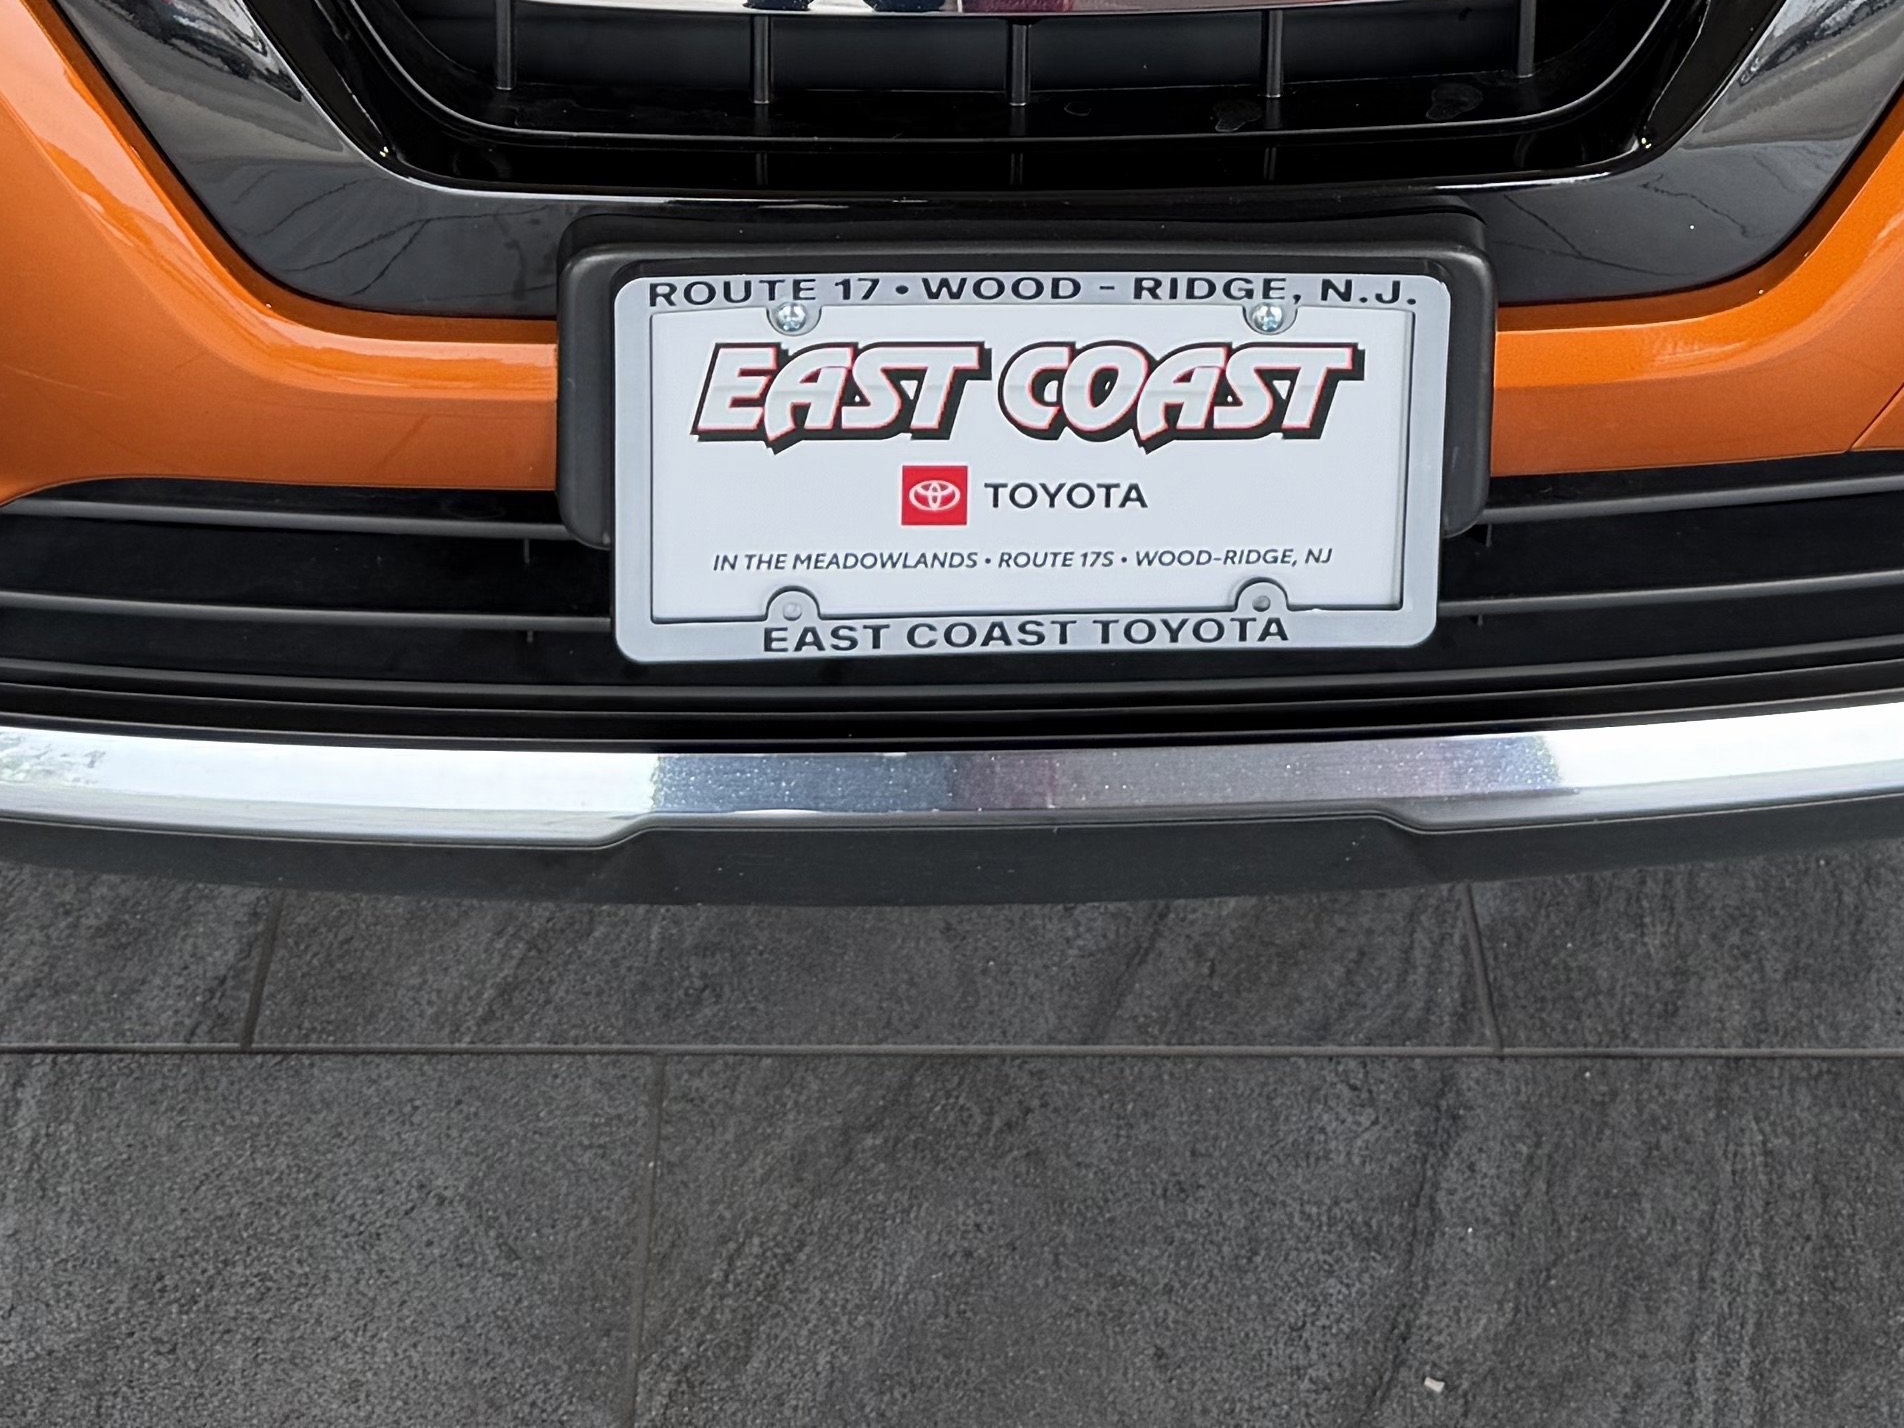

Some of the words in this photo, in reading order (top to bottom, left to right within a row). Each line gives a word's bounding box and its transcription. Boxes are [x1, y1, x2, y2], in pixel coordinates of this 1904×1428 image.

[649, 277, 817, 307] ROUTE
[834, 277, 880, 302] 17
[921, 276, 1082, 302] WOOD
[1133, 277, 1302, 305] RIDGE,
[1320, 278, 1417, 306] N.J.
[690, 341, 992, 454] EAST
[998, 340, 1366, 454] COAST
[984, 482, 1149, 509] TOYOTA
[713, 554, 739, 572] IN
[745, 554, 787, 571] THE
[793, 551, 978, 571] MEADOWLANDS
[998, 550, 1074, 569] ROUTE
[1080, 550, 1115, 568] 17S
[1135, 548, 1298, 567] WOOD-RIDGE,
[1304, 547, 1333, 564] NJ
[763, 624, 892, 653] EAST
[906, 620, 1078, 649] COAST
[1092, 617, 1290, 645] TOYOTA
